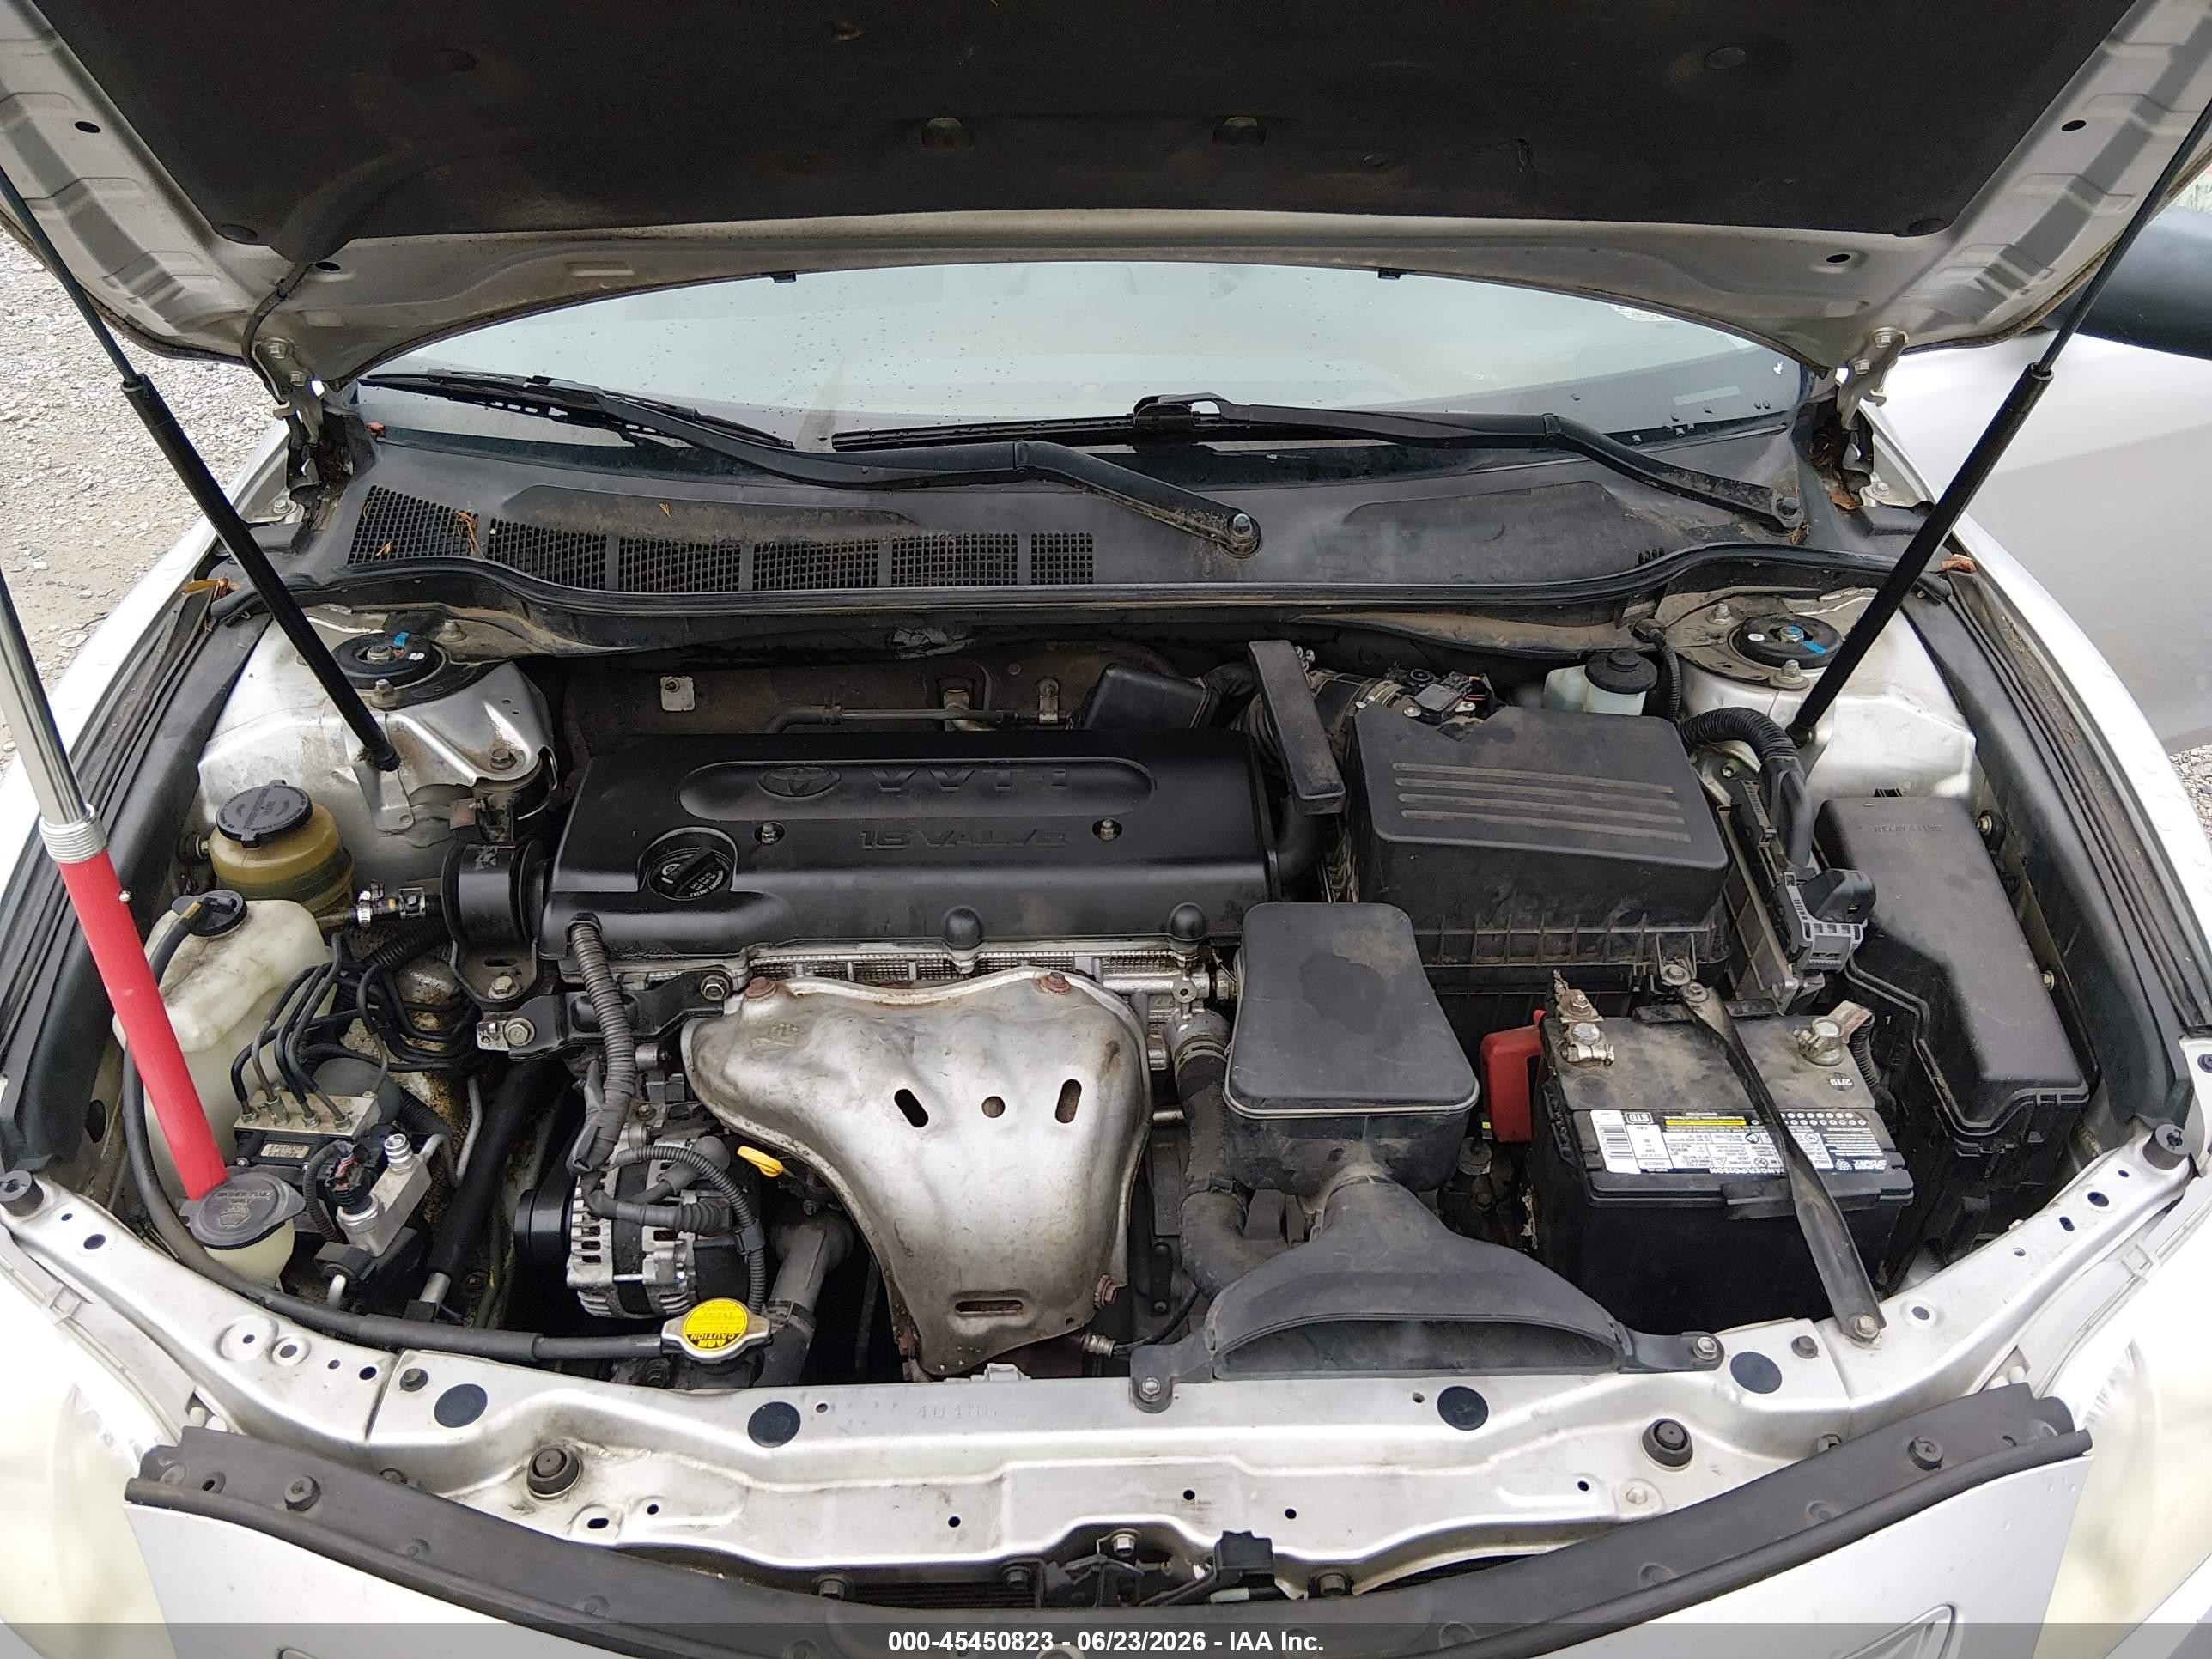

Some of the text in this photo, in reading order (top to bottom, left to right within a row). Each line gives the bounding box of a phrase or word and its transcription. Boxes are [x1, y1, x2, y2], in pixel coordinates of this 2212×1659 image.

[1873, 825, 1906, 834] RELAY
[1830, 1078, 1853, 1086] 2/19
[690, 1332, 736, 1340] CAUTION
